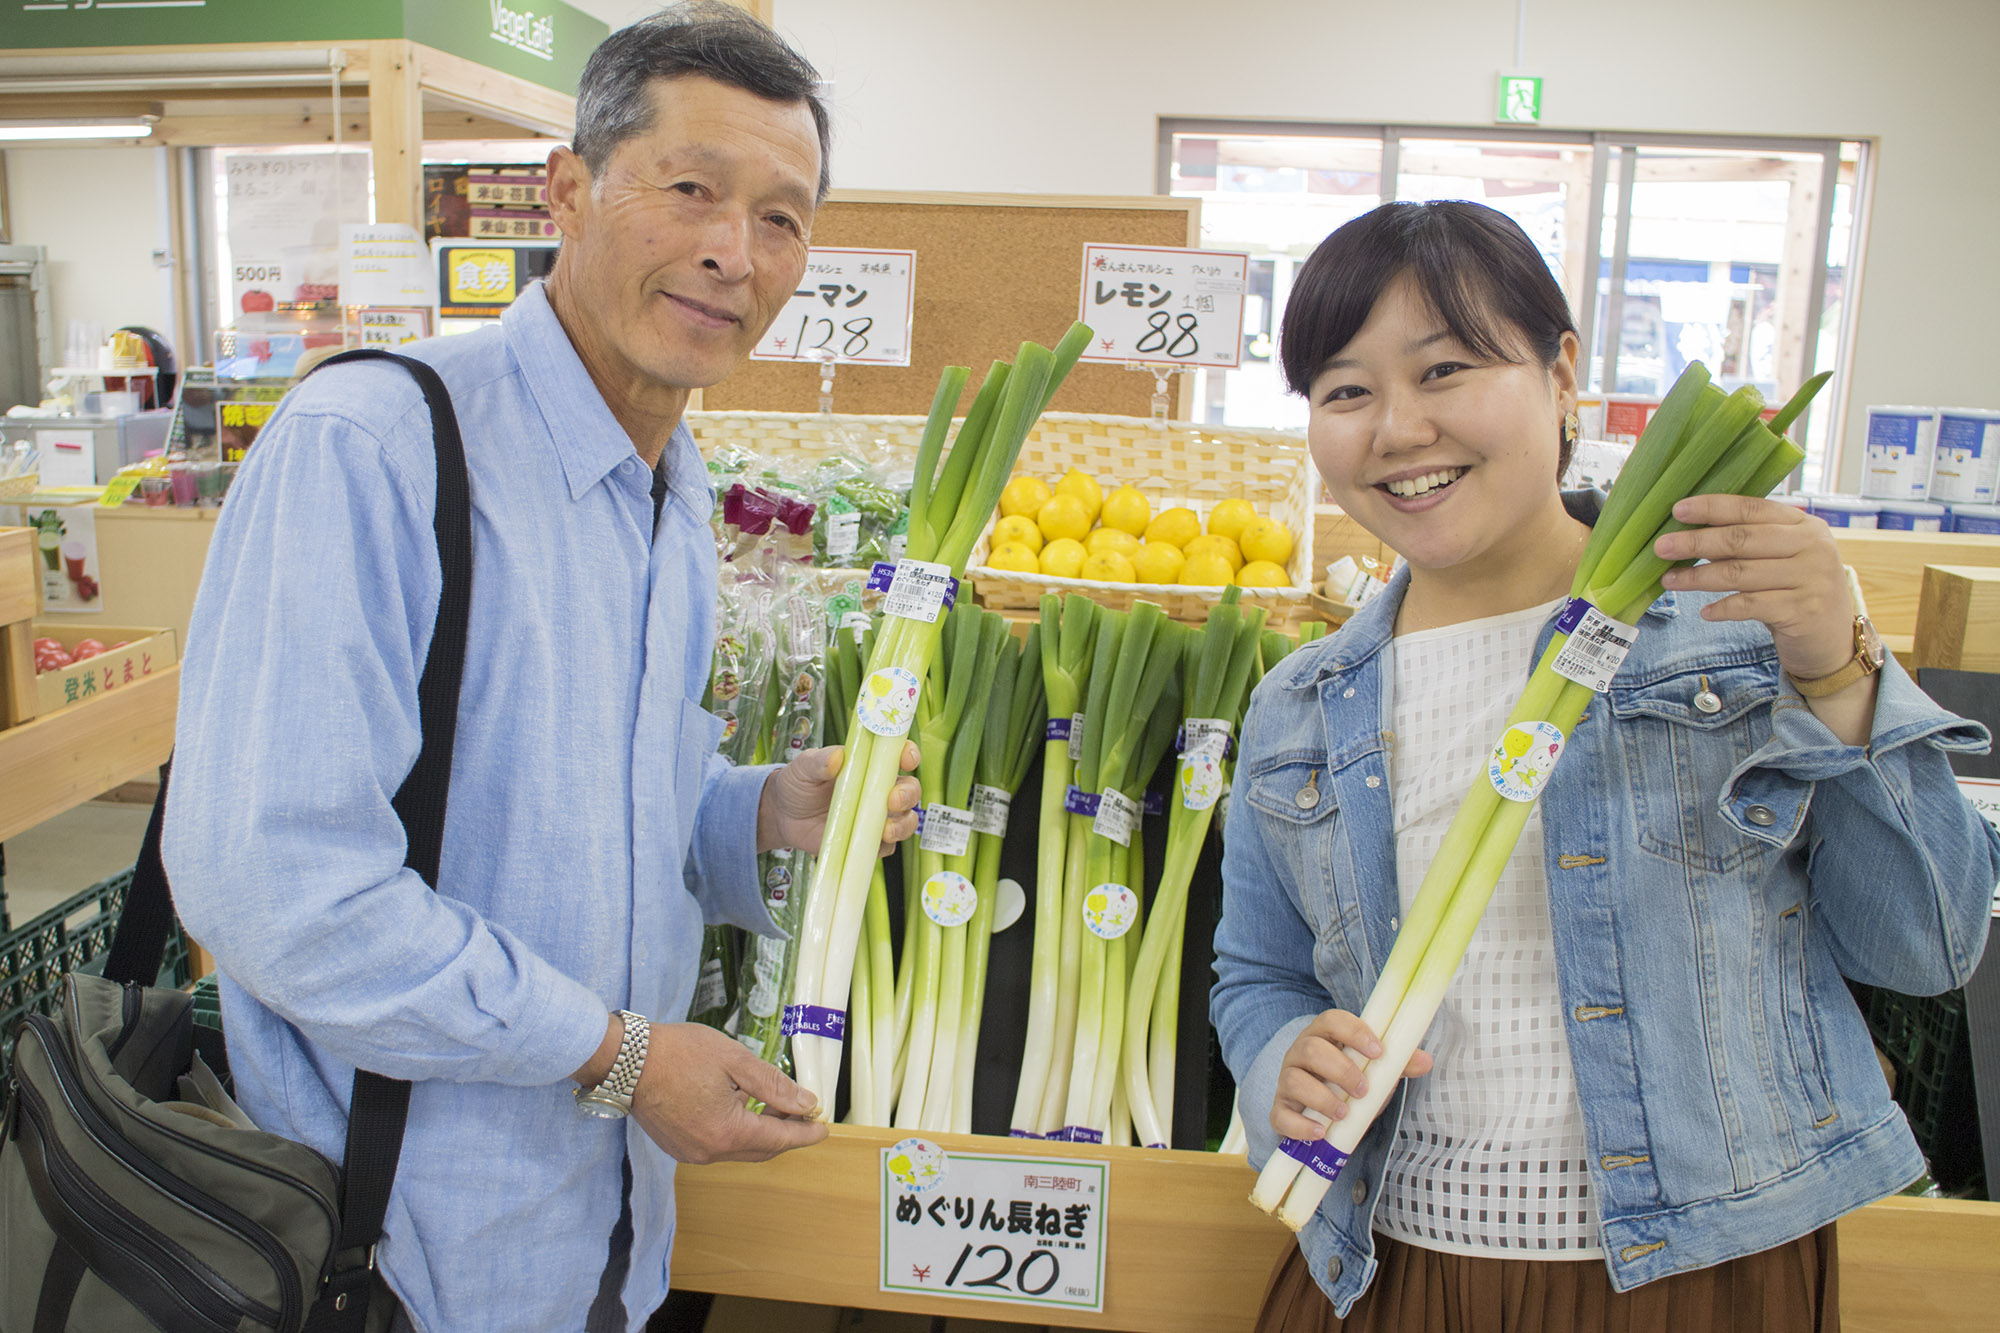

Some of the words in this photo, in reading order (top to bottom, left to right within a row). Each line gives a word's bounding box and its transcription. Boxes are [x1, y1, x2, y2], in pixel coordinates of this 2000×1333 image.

[235, 266, 281, 282] 500円
[455, 261, 511, 290] 食券
[1099, 261, 1174, 275] さんさんマルシェ
[1095, 280, 1172, 308] レモン
[773, 337, 787, 351] ¥
[792, 315, 873, 359] 128
[1101, 339, 1115, 353] ¥
[1136, 311, 1199, 358] 88
[1311, 1155, 1337, 1176] FRESH
[1023, 1174, 1082, 1192] 南三陸町
[896, 1194, 1091, 1238] めぐりん長ねぎ
[912, 1263, 931, 1283] ¥
[945, 1242, 1060, 1296] 120
